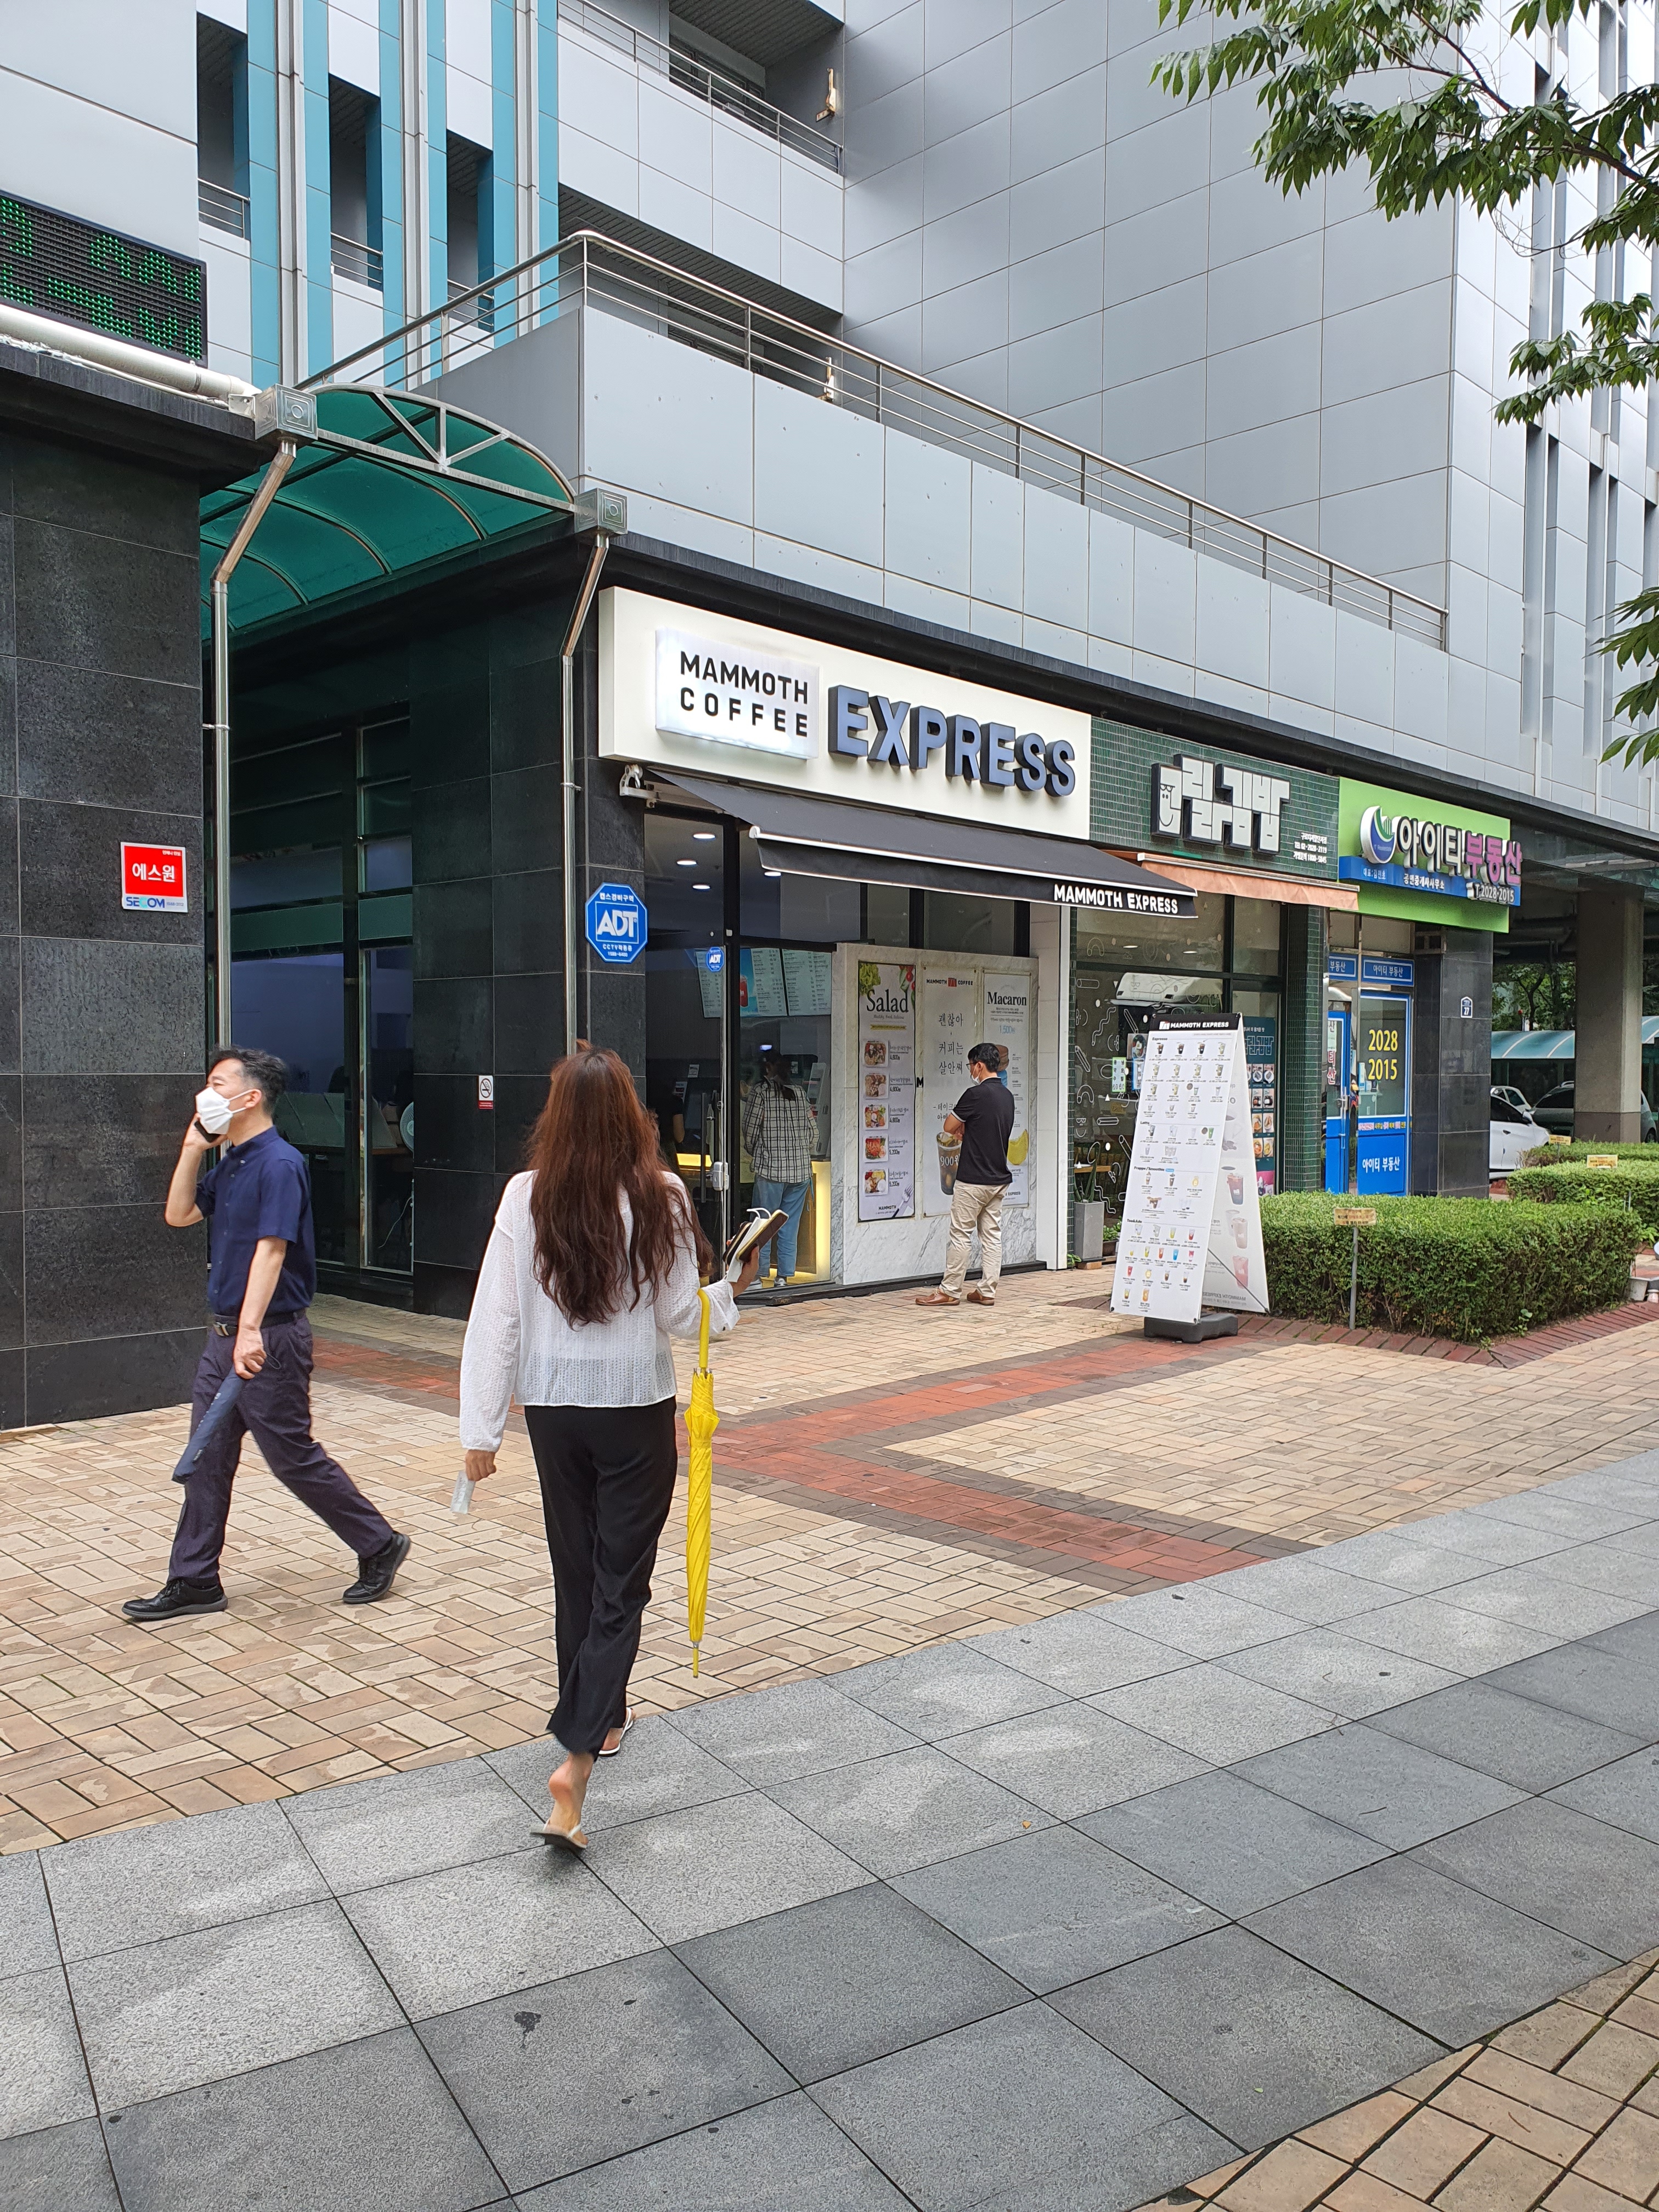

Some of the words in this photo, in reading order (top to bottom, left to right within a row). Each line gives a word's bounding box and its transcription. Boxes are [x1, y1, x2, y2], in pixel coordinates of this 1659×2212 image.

[680, 651, 809, 704] MAMMOTH
[680, 687, 808, 737] COFFEE
[828, 685, 1075, 798] EXPRESS
[132, 863, 175, 882] 에스원
[126, 896, 165, 908] SECOM
[1054, 884, 1122, 908] MAMMOTH
[1127, 893, 1178, 913] EXPRESS
[597, 910, 637, 938] ADT
[709, 955, 721, 964] ADT
[1330, 961, 1346, 973] 부동산
[1373, 964, 1387, 975] 아이티
[1389, 966, 1403, 978] 부동산
[867, 989, 909, 1013] Salad
[988, 992, 1027, 1006] Macaron
[938, 1013, 963, 1027] 괜찮아
[938, 1042, 963, 1055] 커피는
[1368, 1029, 1398, 1051] 2028
[1368, 1058, 1397, 1080] 2015
[1362, 1158, 1380, 1173] 아이티
[1382, 1156, 1401, 1172] 부동산
